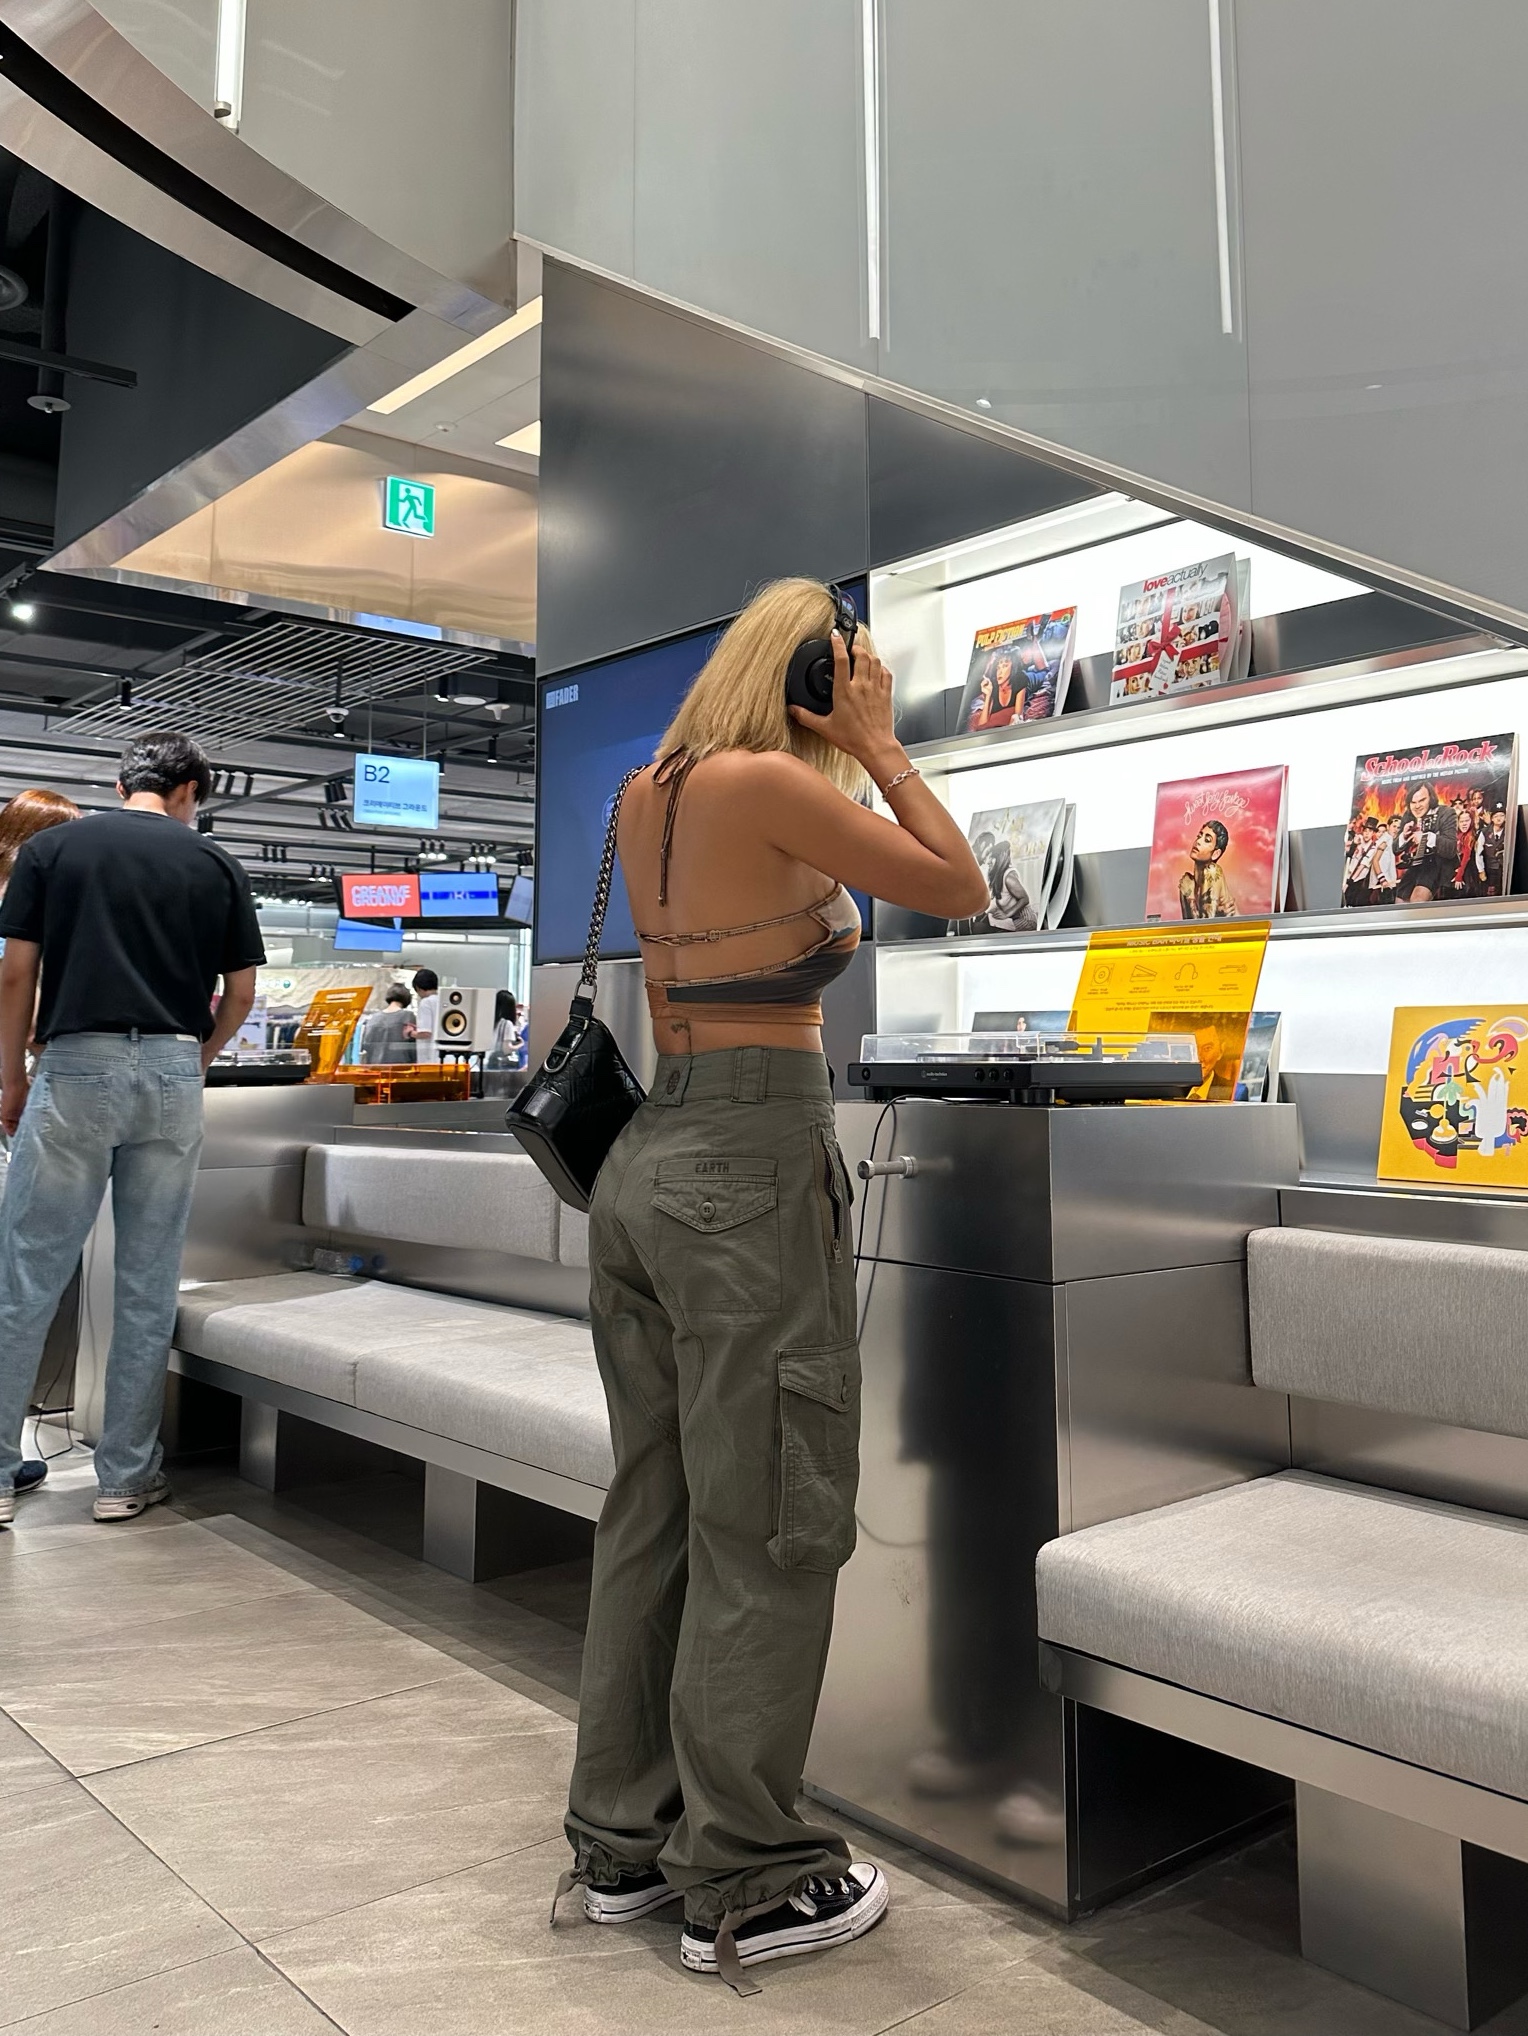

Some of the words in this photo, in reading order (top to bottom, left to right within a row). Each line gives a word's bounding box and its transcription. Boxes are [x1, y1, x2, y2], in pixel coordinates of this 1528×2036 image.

[1360, 749, 1430, 782] School
[1440, 740, 1499, 767] Rock
[364, 764, 390, 783] B2
[695, 1162, 730, 1173] EARTH
